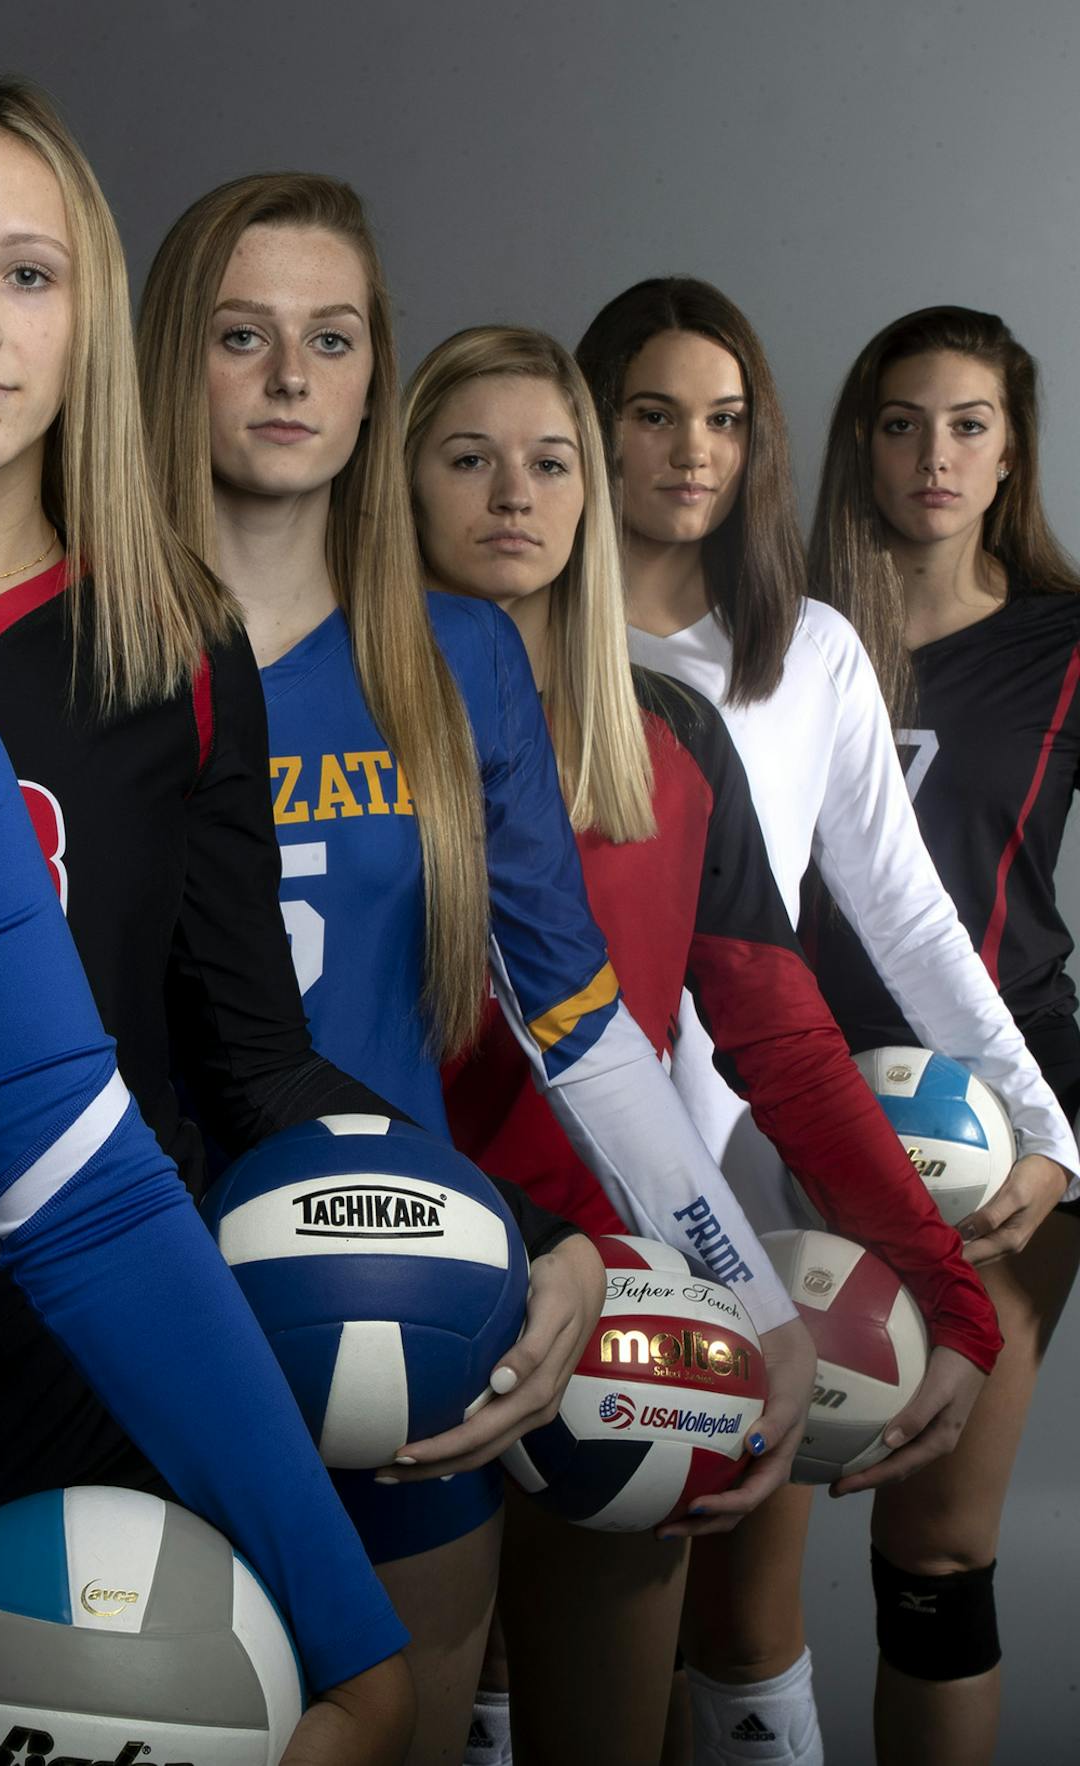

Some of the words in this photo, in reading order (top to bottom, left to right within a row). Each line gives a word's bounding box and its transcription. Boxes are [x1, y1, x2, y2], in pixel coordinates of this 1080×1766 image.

[293, 1185, 446, 1228] TACHIKARA
[673, 1195, 754, 1283] PRIDE
[607, 1276, 675, 1303] Super
[682, 1283, 742, 1320] Touch
[600, 1329, 751, 1380] molten
[88, 1588, 139, 1604] avca
